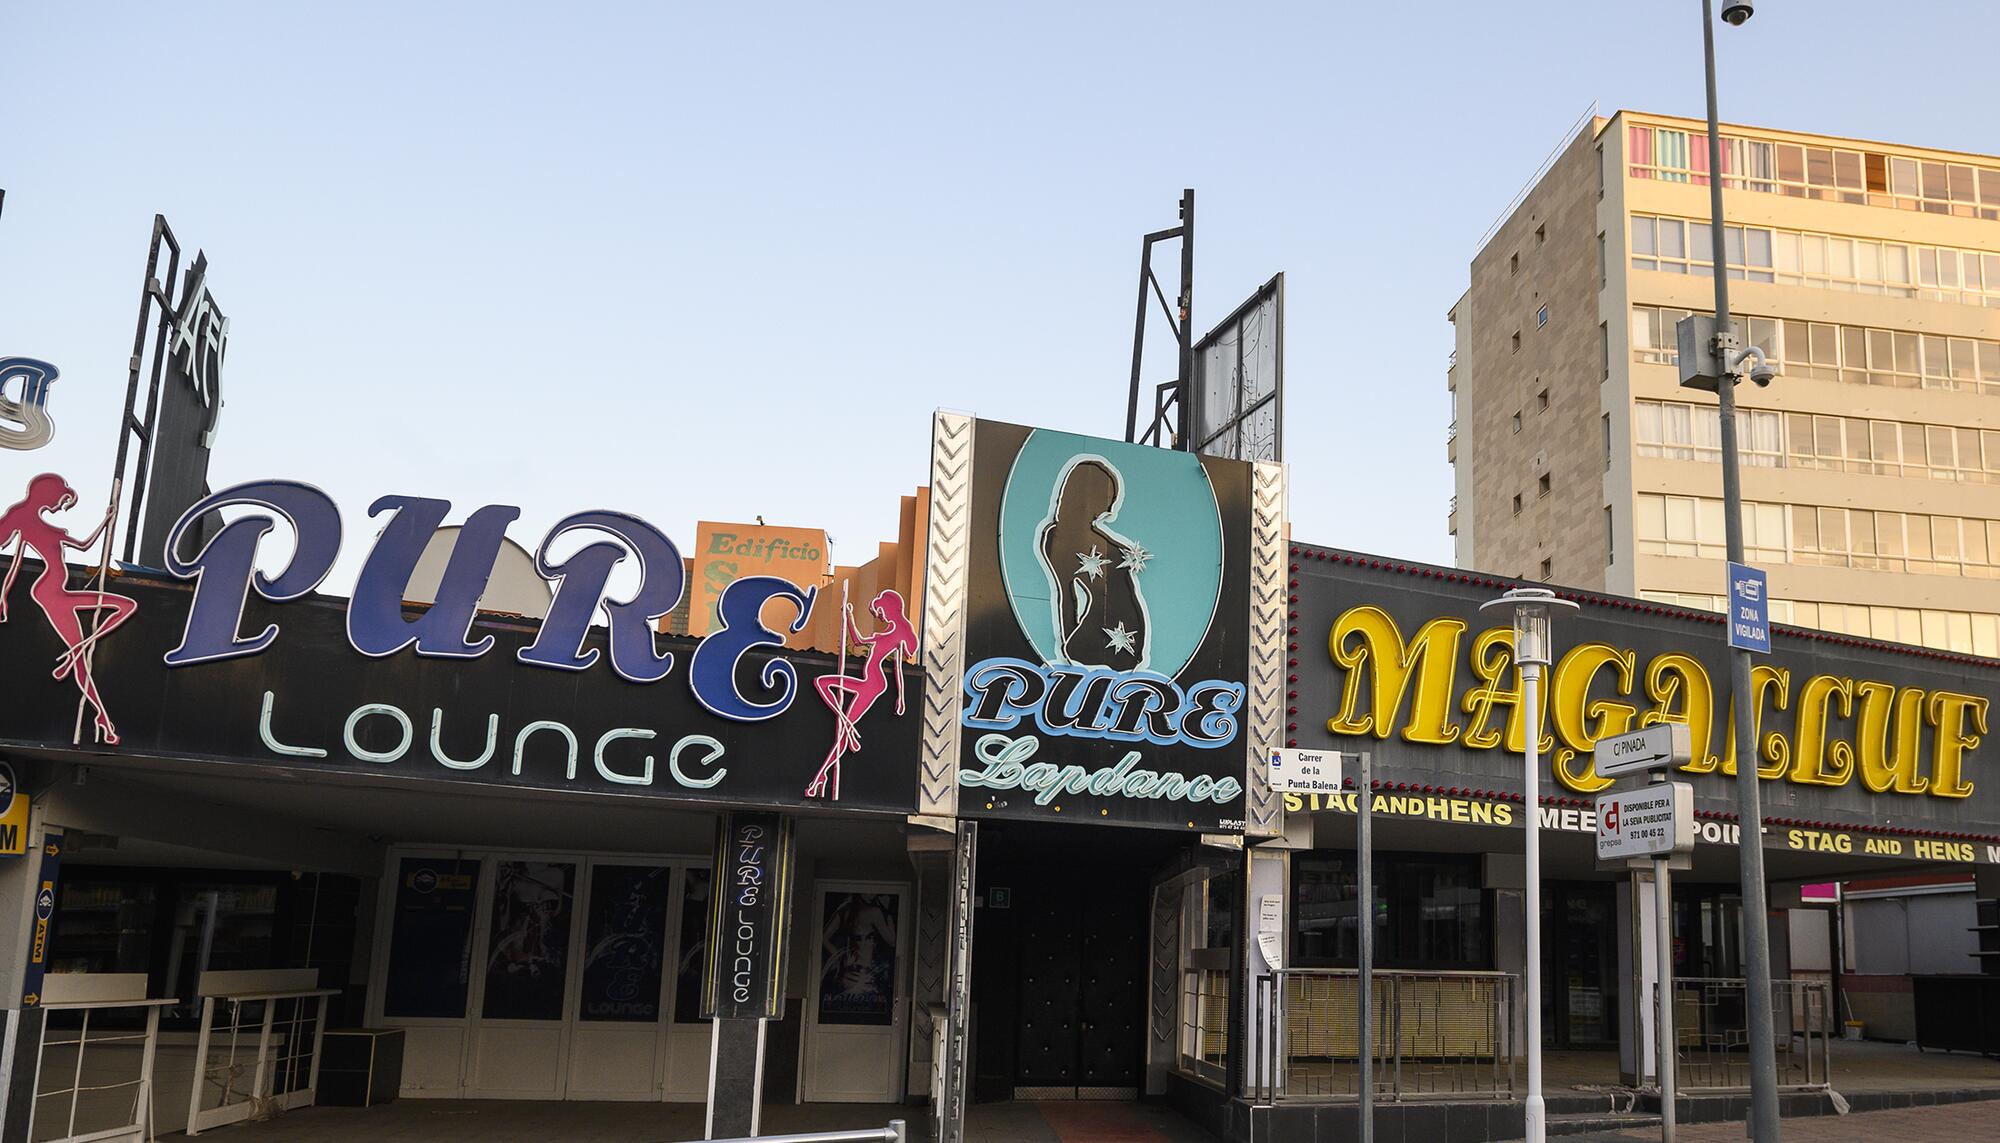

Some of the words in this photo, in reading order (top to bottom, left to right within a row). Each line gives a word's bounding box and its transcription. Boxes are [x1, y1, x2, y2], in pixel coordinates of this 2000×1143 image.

[706, 532, 820, 564] Edificio
[163, 479, 819, 723] PURE
[1740, 606, 1759, 622] ZONA
[1735, 623, 1766, 641] VIGILADA
[963, 658, 1245, 747] PURE
[1327, 604, 1990, 799] MAGALLUF
[1621, 737, 1647, 755] PINADA
[1298, 752, 1323, 762] Carrer
[959, 733, 1243, 805] Lapdance
[1301, 766, 1311, 775] de
[1312, 766, 1320, 775] la
[1288, 779, 1310, 789] Punta
[1312, 781, 1338, 791] Balena
[1623, 800, 1654, 813] DISPONIBLE
[1654, 799, 1665, 809] PER
[1622, 818, 1629, 827] LA
[1630, 816, 1643, 826] SEVA
[1643, 812, 1673, 825] PUBLICITAT
[1630, 830, 1640, 840] 971
[1641, 829, 1648, 839] 00
[1649, 828, 1657, 838] 45
[1657, 827, 1665, 837] 22
[1600, 838, 1622, 850] grepsa
[1788, 829, 1852, 854] STAG
[1864, 838, 1902, 855] AND
[1914, 840, 1976, 863] HENS
[737, 825, 764, 906] PURE
[34, 923, 45, 958] ATM
